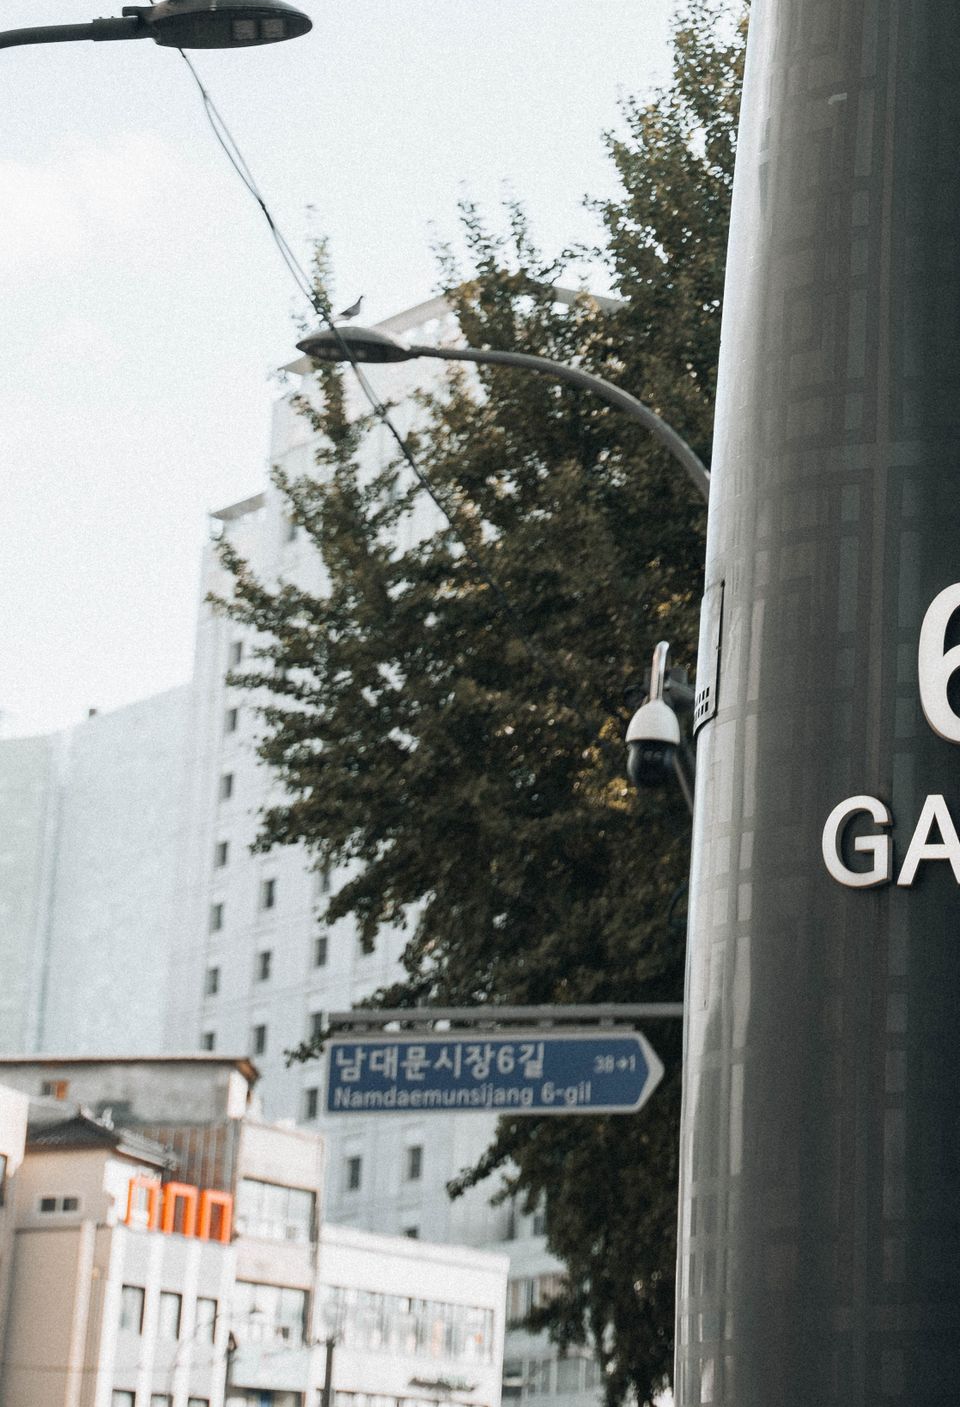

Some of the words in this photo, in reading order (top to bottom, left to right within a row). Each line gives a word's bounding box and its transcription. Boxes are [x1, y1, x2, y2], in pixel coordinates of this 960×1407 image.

[335, 1042, 545, 1083] 남대문시장6길
[333, 1083, 533, 1109] Namdaemunsijang
[541, 1081, 592, 1106] 6-gil
